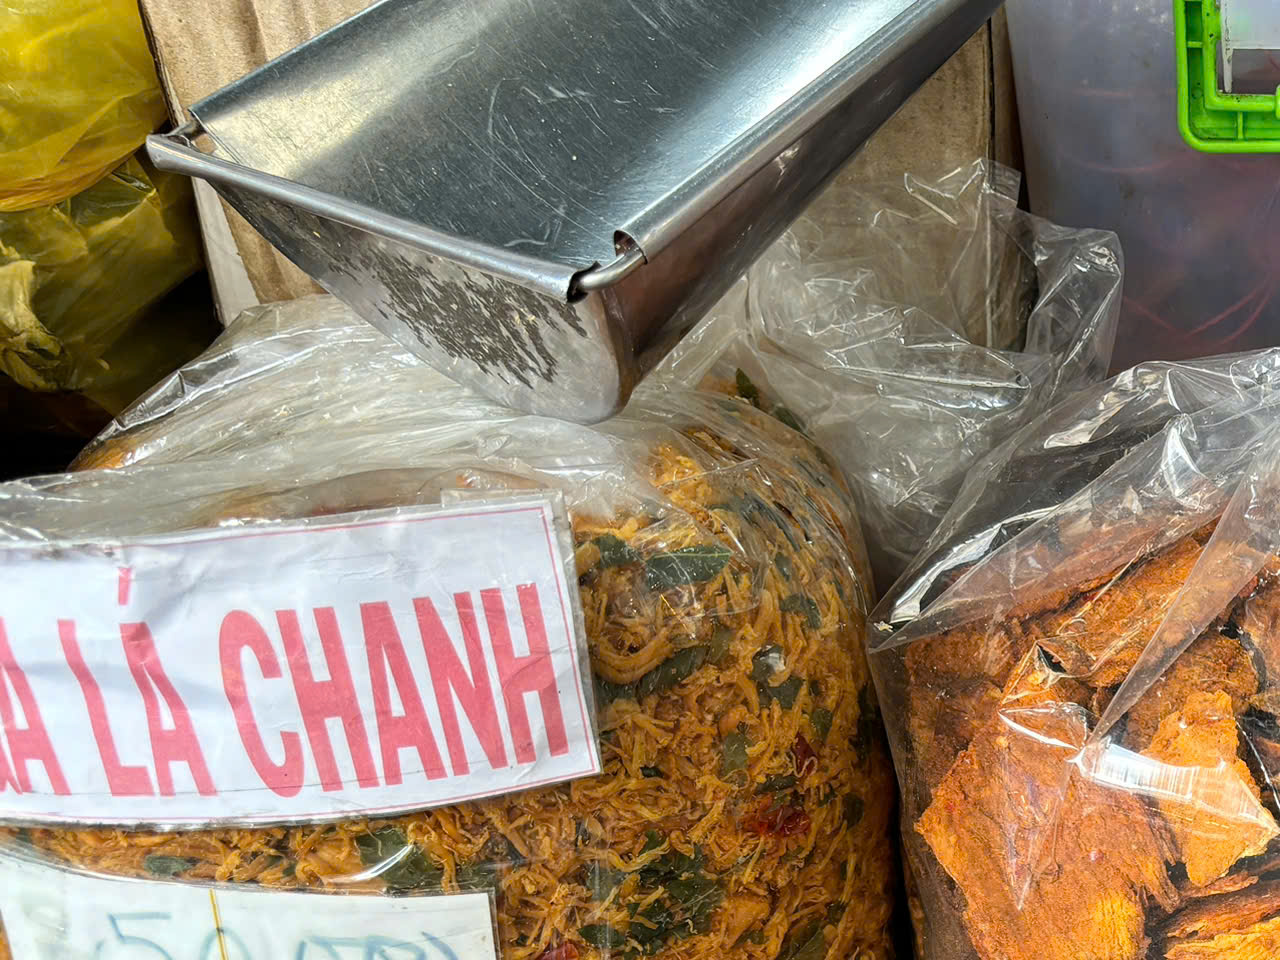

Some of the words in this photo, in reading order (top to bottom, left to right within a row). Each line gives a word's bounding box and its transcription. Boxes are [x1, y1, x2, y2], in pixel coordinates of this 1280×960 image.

[0, 617, 70, 797] A
[56, 567, 217, 797] LÁ
[218, 582, 570, 798] CHANH
